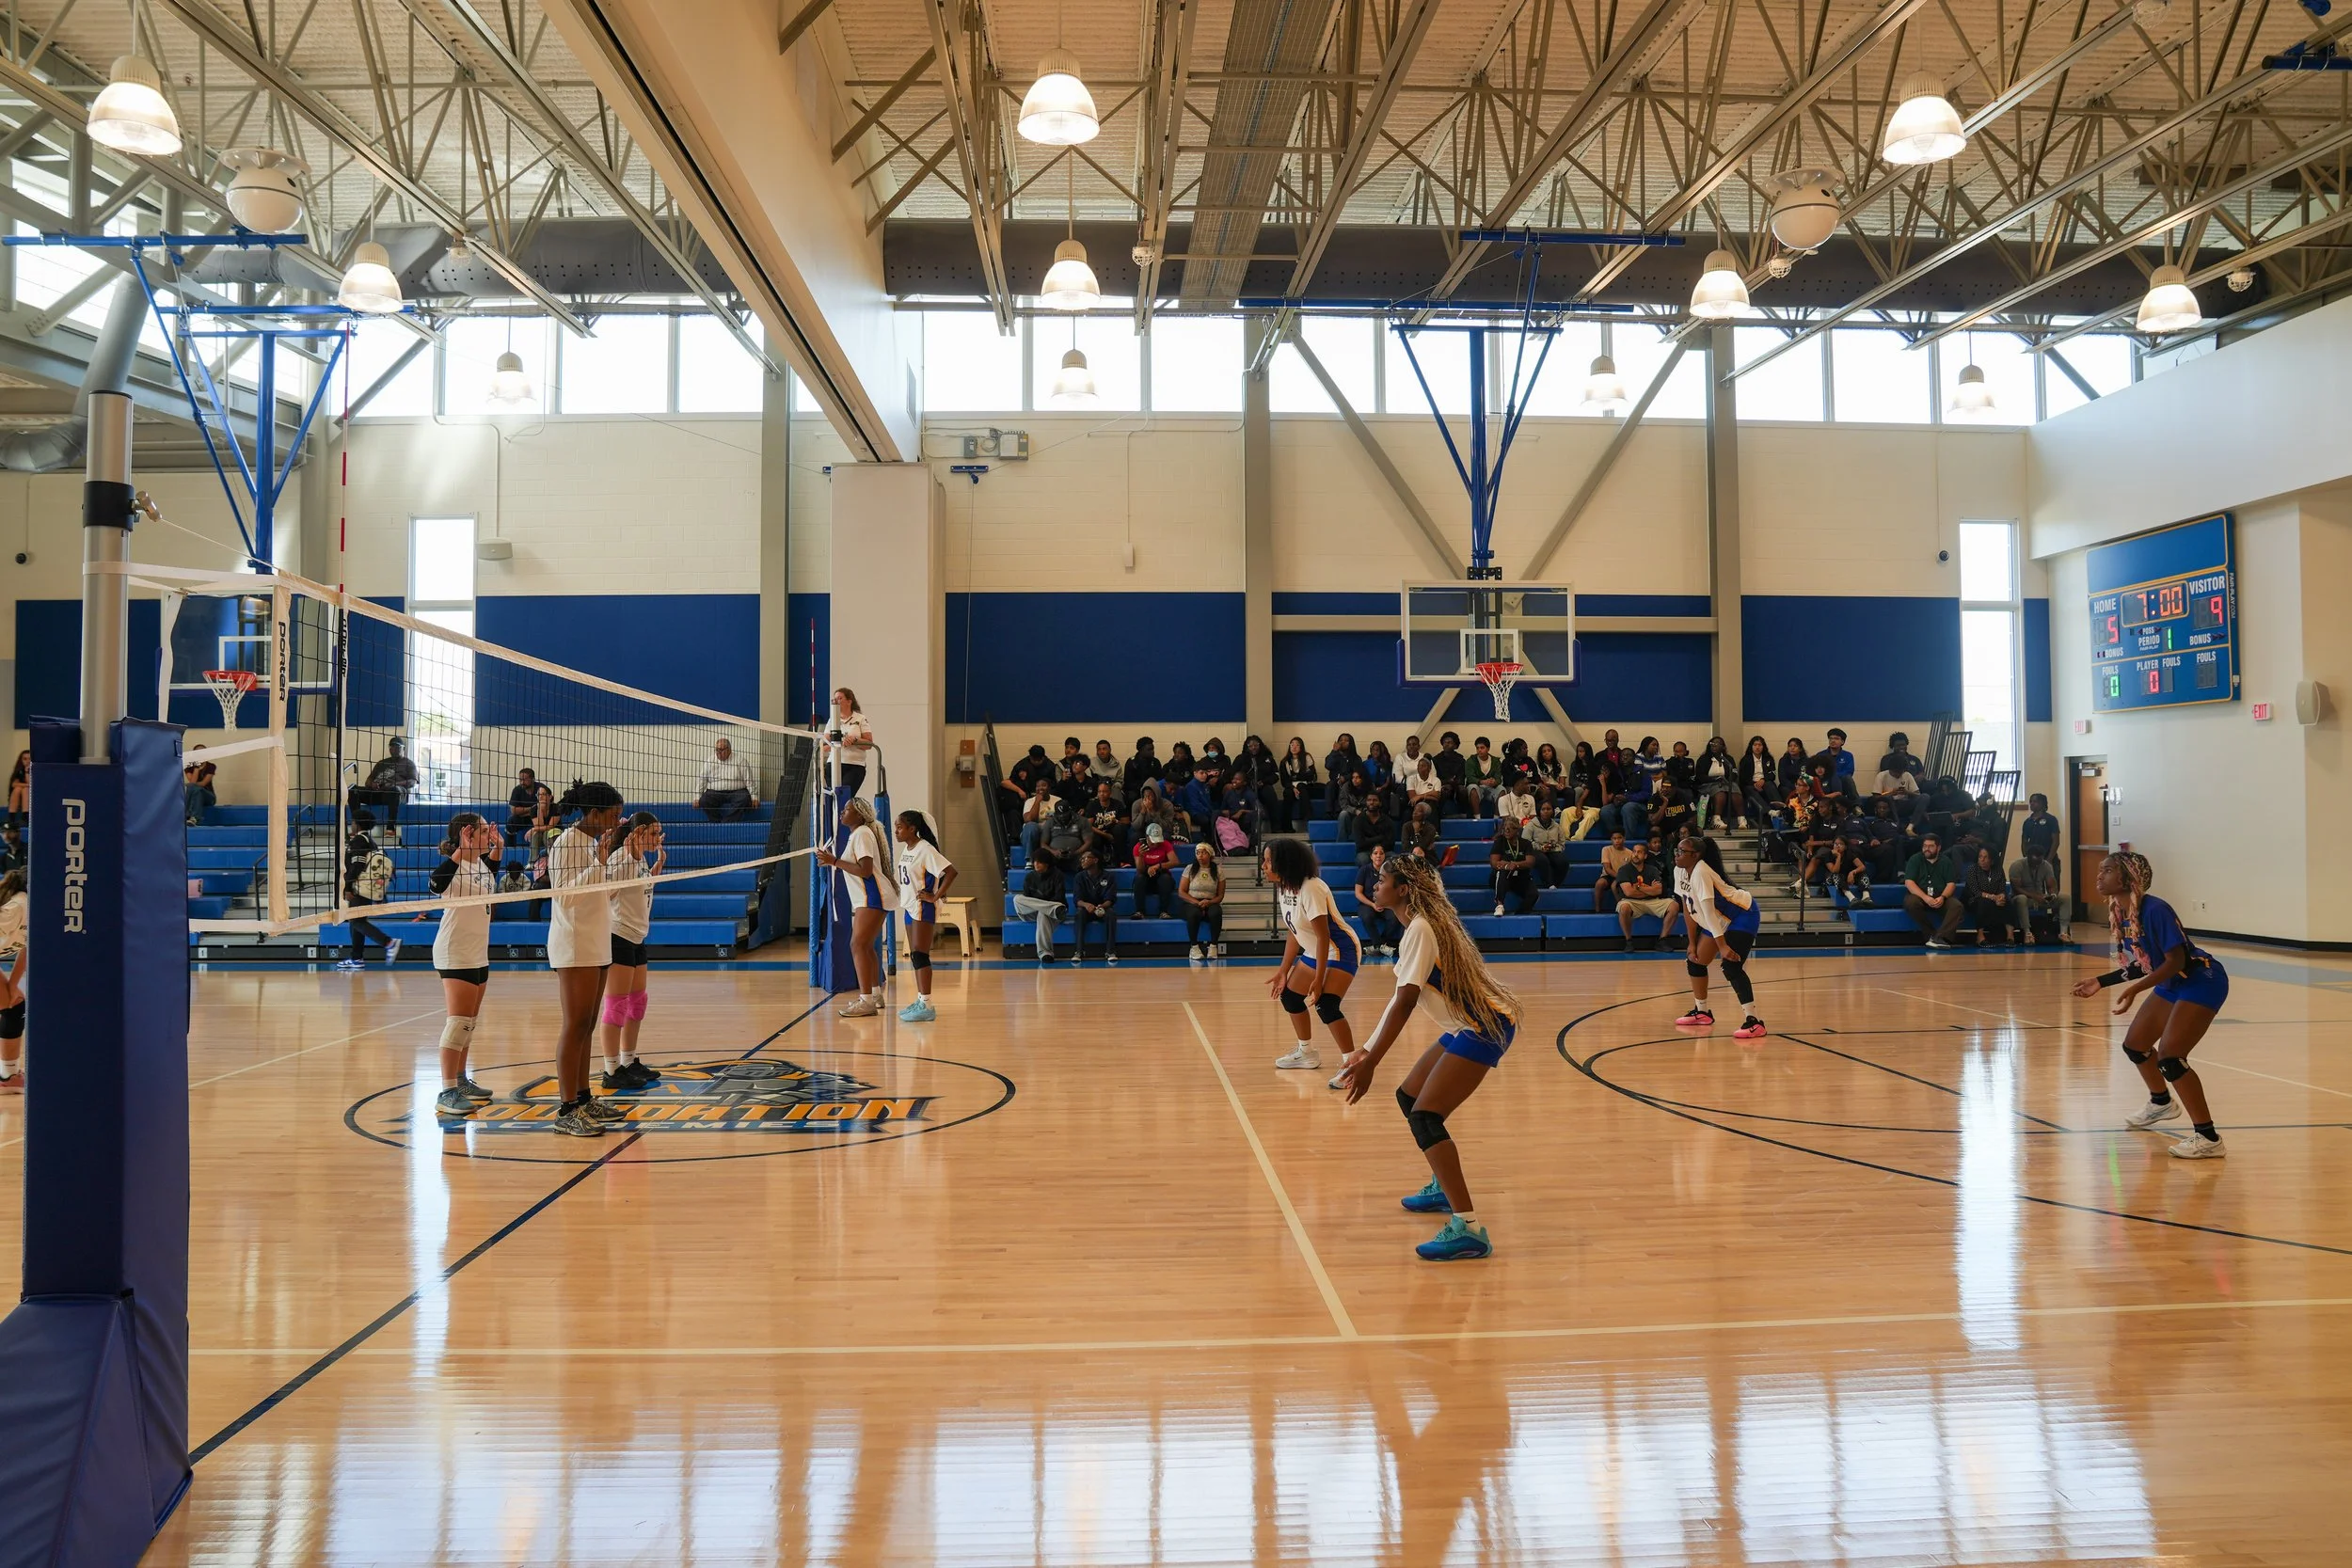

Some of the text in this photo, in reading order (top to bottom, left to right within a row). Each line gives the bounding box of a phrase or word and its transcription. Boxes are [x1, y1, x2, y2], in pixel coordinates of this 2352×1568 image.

[2188, 576, 2226, 594] VISITOR
[2093, 597, 2117, 614] HOME
[2137, 586, 2183, 618] 7:00
[2210, 595, 2223, 625] 9
[2107, 616, 2119, 643] 5
[2142, 626, 2154, 635] POSS
[2137, 635, 2160, 646] PERIOD
[2167, 628, 2172, 650] 1
[2188, 633, 2212, 645] BONUS
[2105, 647, 2124, 657] BONUS
[2196, 651, 2217, 663] FOULS
[2102, 665, 2119, 675] FOULS
[2137, 657, 2181, 671] PLAYER FOULS
[2110, 675, 2120, 697] 0
[2149, 671, 2160, 693] 0
[2253, 704, 2267, 719] EXIT
[898, 864, 911, 885] 13
